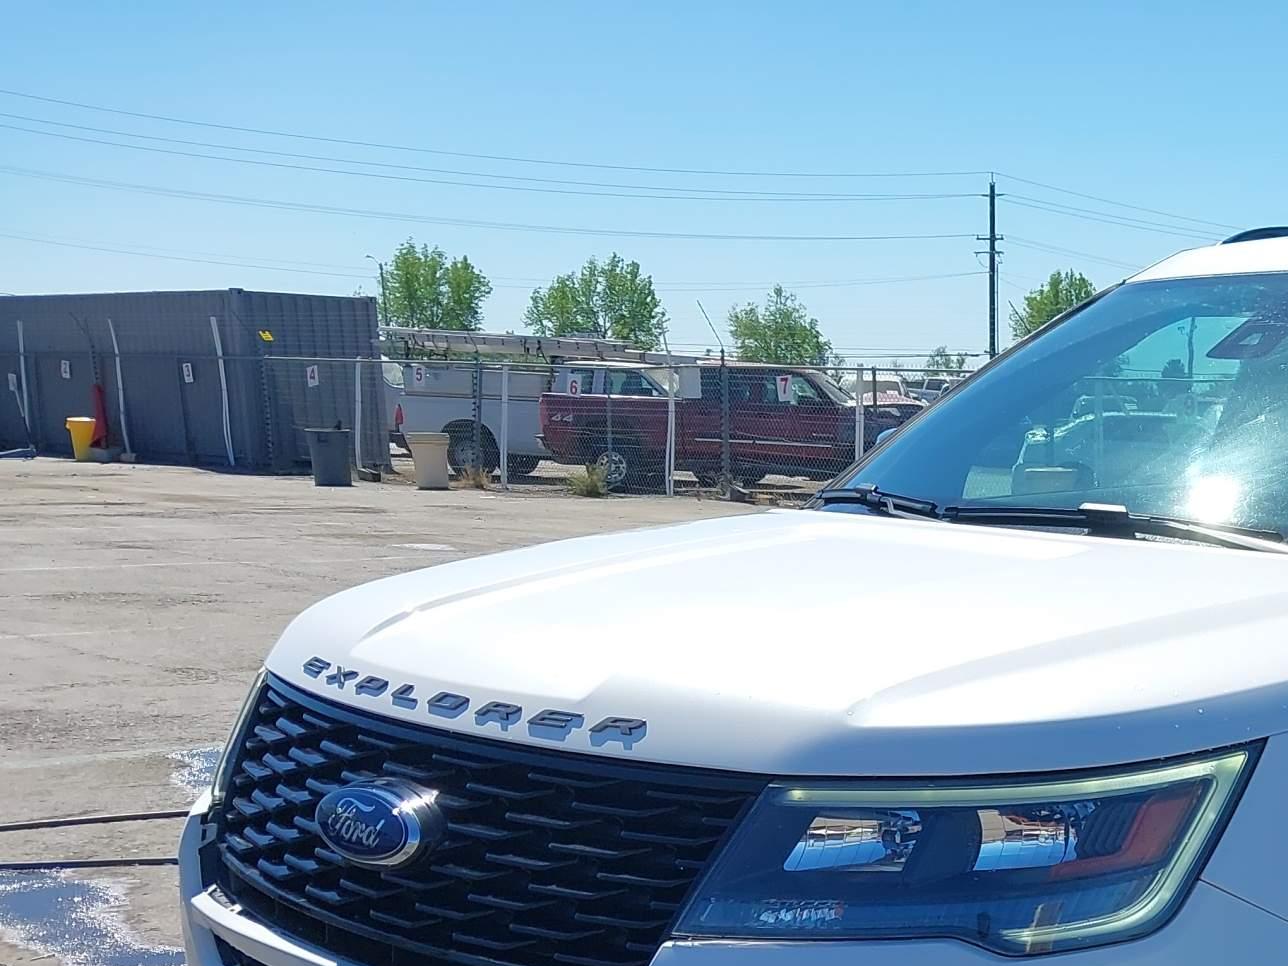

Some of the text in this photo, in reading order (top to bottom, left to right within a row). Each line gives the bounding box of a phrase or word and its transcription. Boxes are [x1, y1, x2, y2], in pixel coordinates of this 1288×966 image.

[416, 368, 423, 382] 5
[569, 379, 578, 395] 6
[779, 377, 789, 395] 7
[302, 655, 648, 751] EXPLORER
[327, 797, 385, 849] Ford
